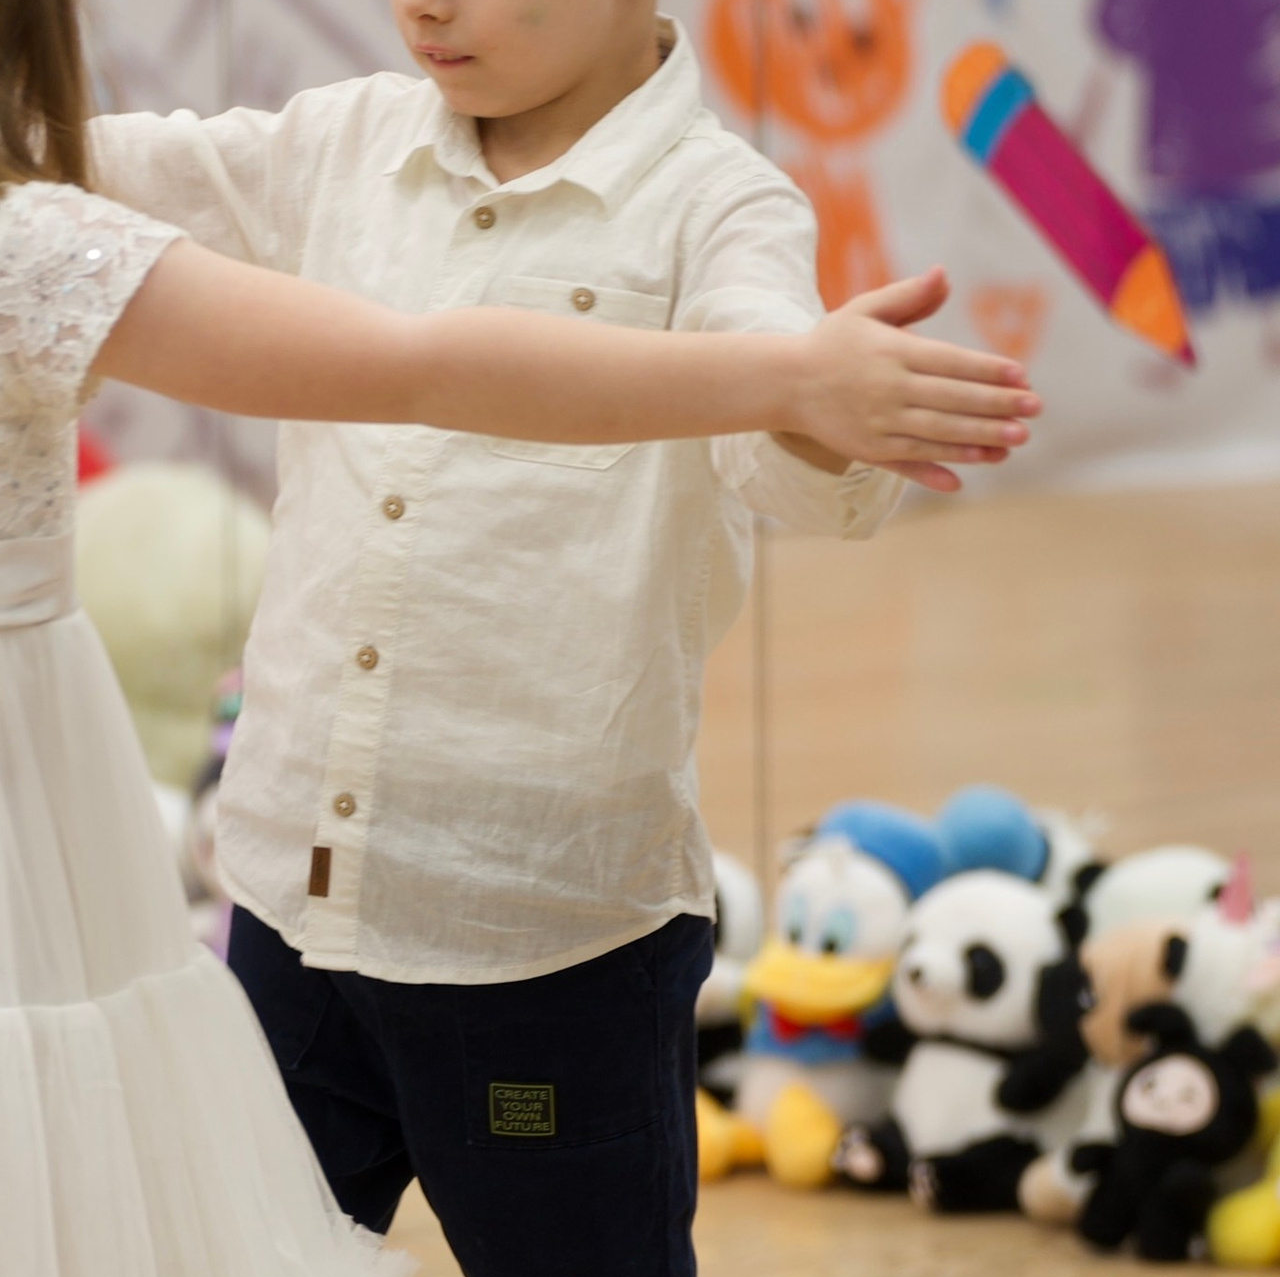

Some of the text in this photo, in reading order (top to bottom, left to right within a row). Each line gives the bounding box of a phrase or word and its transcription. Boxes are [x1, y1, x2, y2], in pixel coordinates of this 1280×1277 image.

[494, 1089, 549, 1100] CREATE
[500, 1100, 543, 1111] YOUR
[502, 1111, 541, 1121] OWN
[494, 1120, 550, 1131] FUTURE
